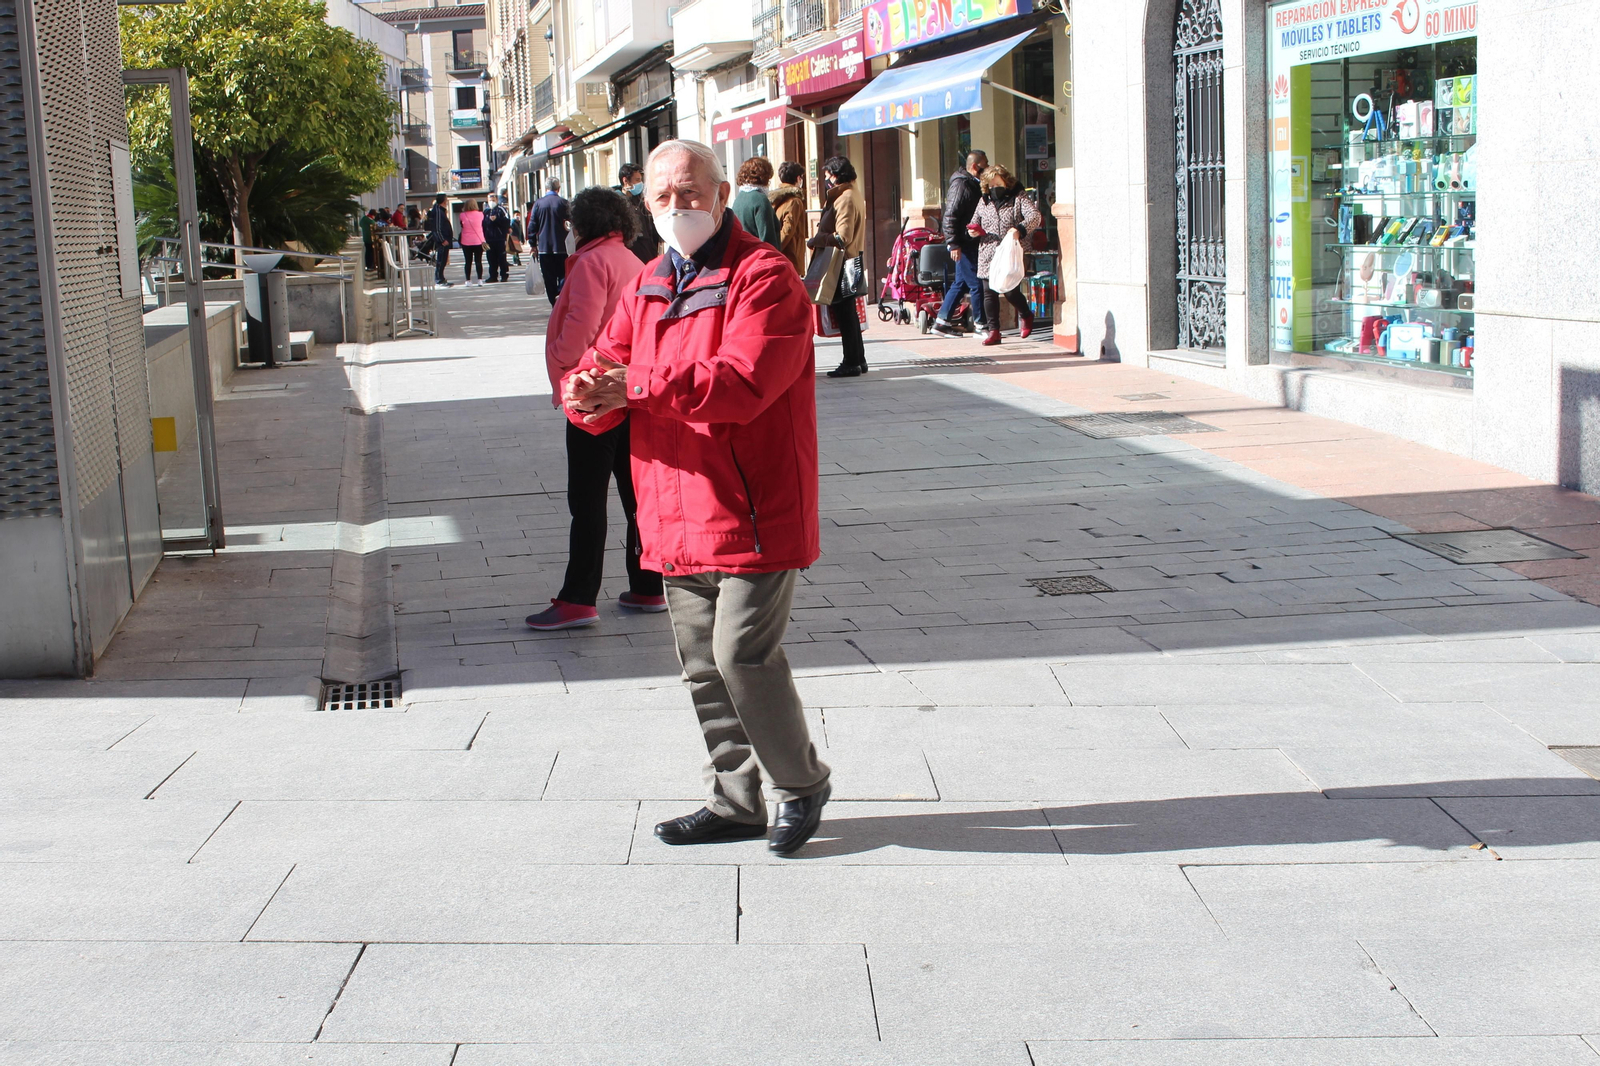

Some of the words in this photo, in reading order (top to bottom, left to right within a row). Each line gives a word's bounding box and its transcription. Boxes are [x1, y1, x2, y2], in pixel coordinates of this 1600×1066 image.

[887, 2, 910, 46] El
[1281, 25, 1324, 47] MÓVILES
[1326, 22, 1333, 39] Y
[1336, 13, 1381, 37] TABLETS
[1425, 12, 1440, 36] 60
[1444, 4, 1478, 33] MINU
[1299, 46, 1329, 61] SERVICIO
[1330, 41, 1361, 56] TÉCNICO
[1283, 236, 1290, 247] LG
[1276, 276, 1291, 299] ZTE
